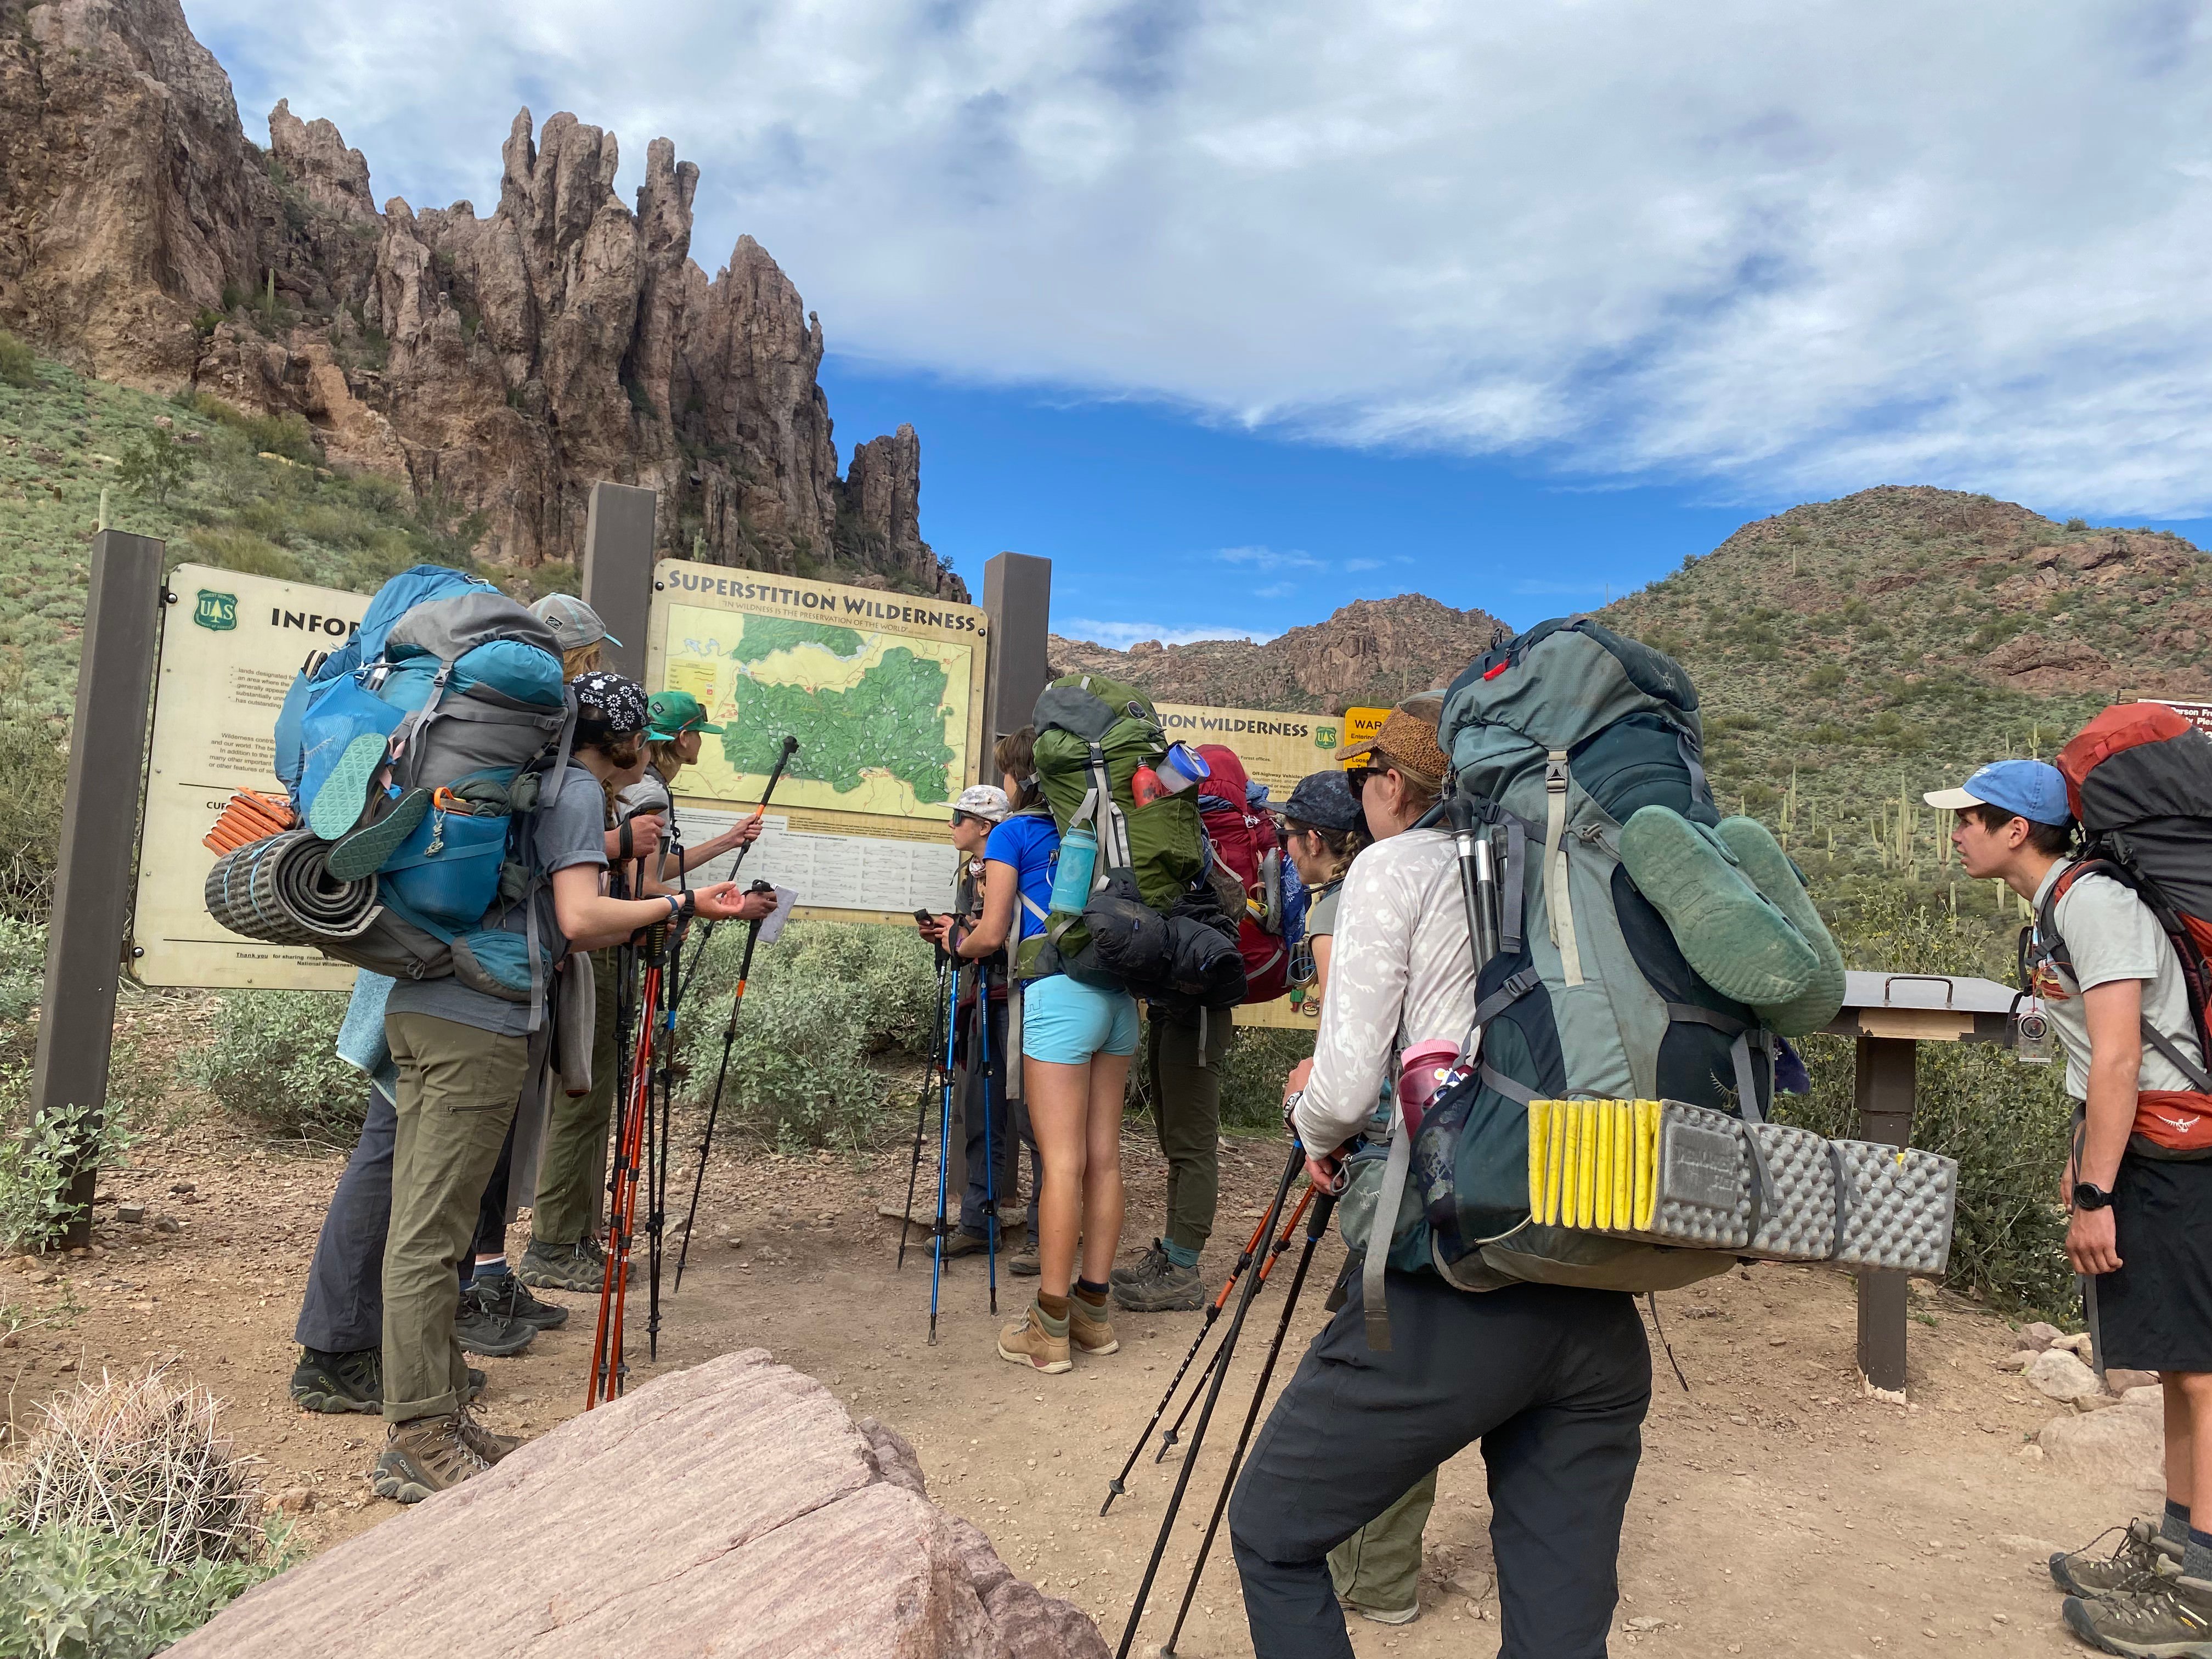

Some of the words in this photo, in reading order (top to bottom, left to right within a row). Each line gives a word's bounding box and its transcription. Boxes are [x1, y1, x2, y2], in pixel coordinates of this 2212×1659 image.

[669, 570, 836, 612] SUPERSTITION
[843, 595, 975, 631] WILDERNESS
[736, 602, 773, 614] WILDNESS
[783, 609, 798, 617] THE
[799, 611, 851, 625] PRESERVATION
[854, 619, 863, 627] OF
[865, 620, 878, 629] THE
[256, 670, 287, 680] designated
[236, 691, 272, 701] substantially
[247, 700, 281, 709] outstanding
[1156, 714, 1197, 729] ION
[1200, 716, 1308, 737] WILDERNESS
[221, 732, 254, 742] Wilderness
[233, 764, 257, 772] features
